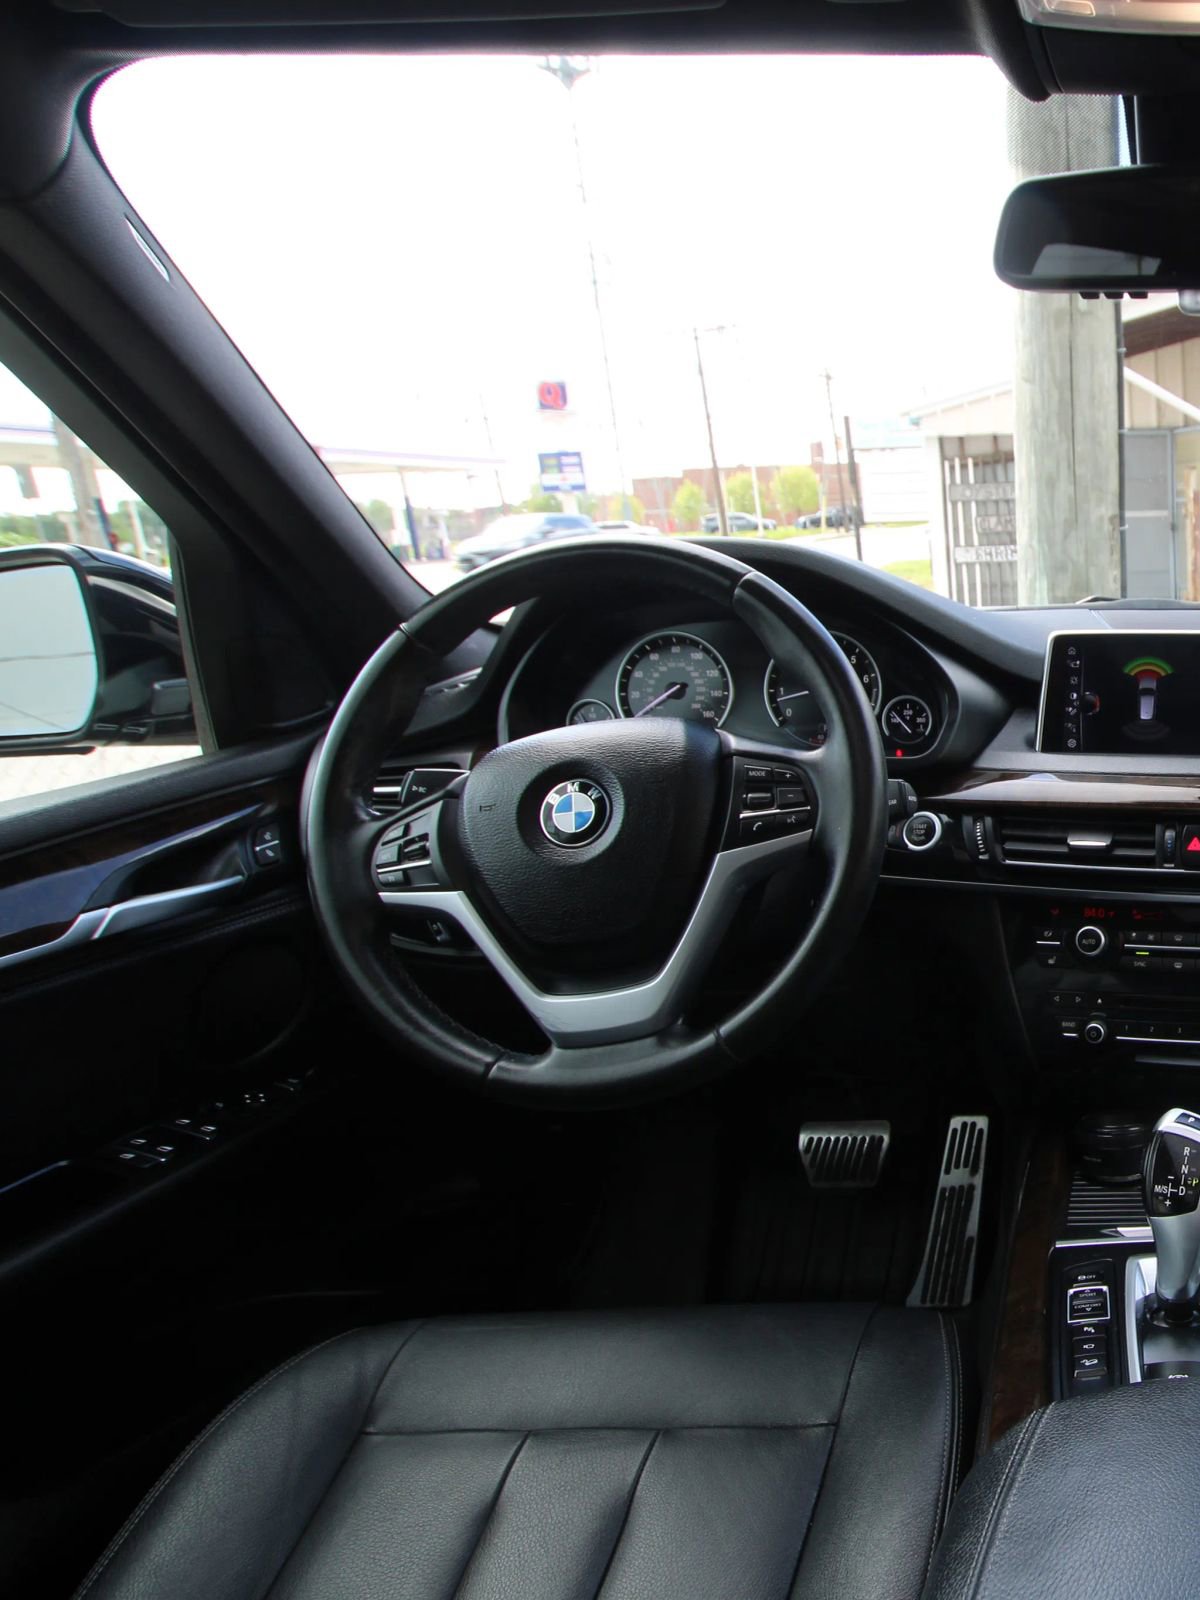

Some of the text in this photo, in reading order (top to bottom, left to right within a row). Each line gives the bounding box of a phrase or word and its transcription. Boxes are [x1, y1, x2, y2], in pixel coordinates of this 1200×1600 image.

[850, 656, 857, 664] 5
[863, 674, 869, 683] 6
[786, 708, 792, 717] 0
[547, 781, 601, 805] BMW
[1184, 1147, 1190, 1156] R
[1181, 1165, 1189, 1174] N
[1192, 1178, 1199, 1187] P
[1178, 1187, 1186, 1195] D
